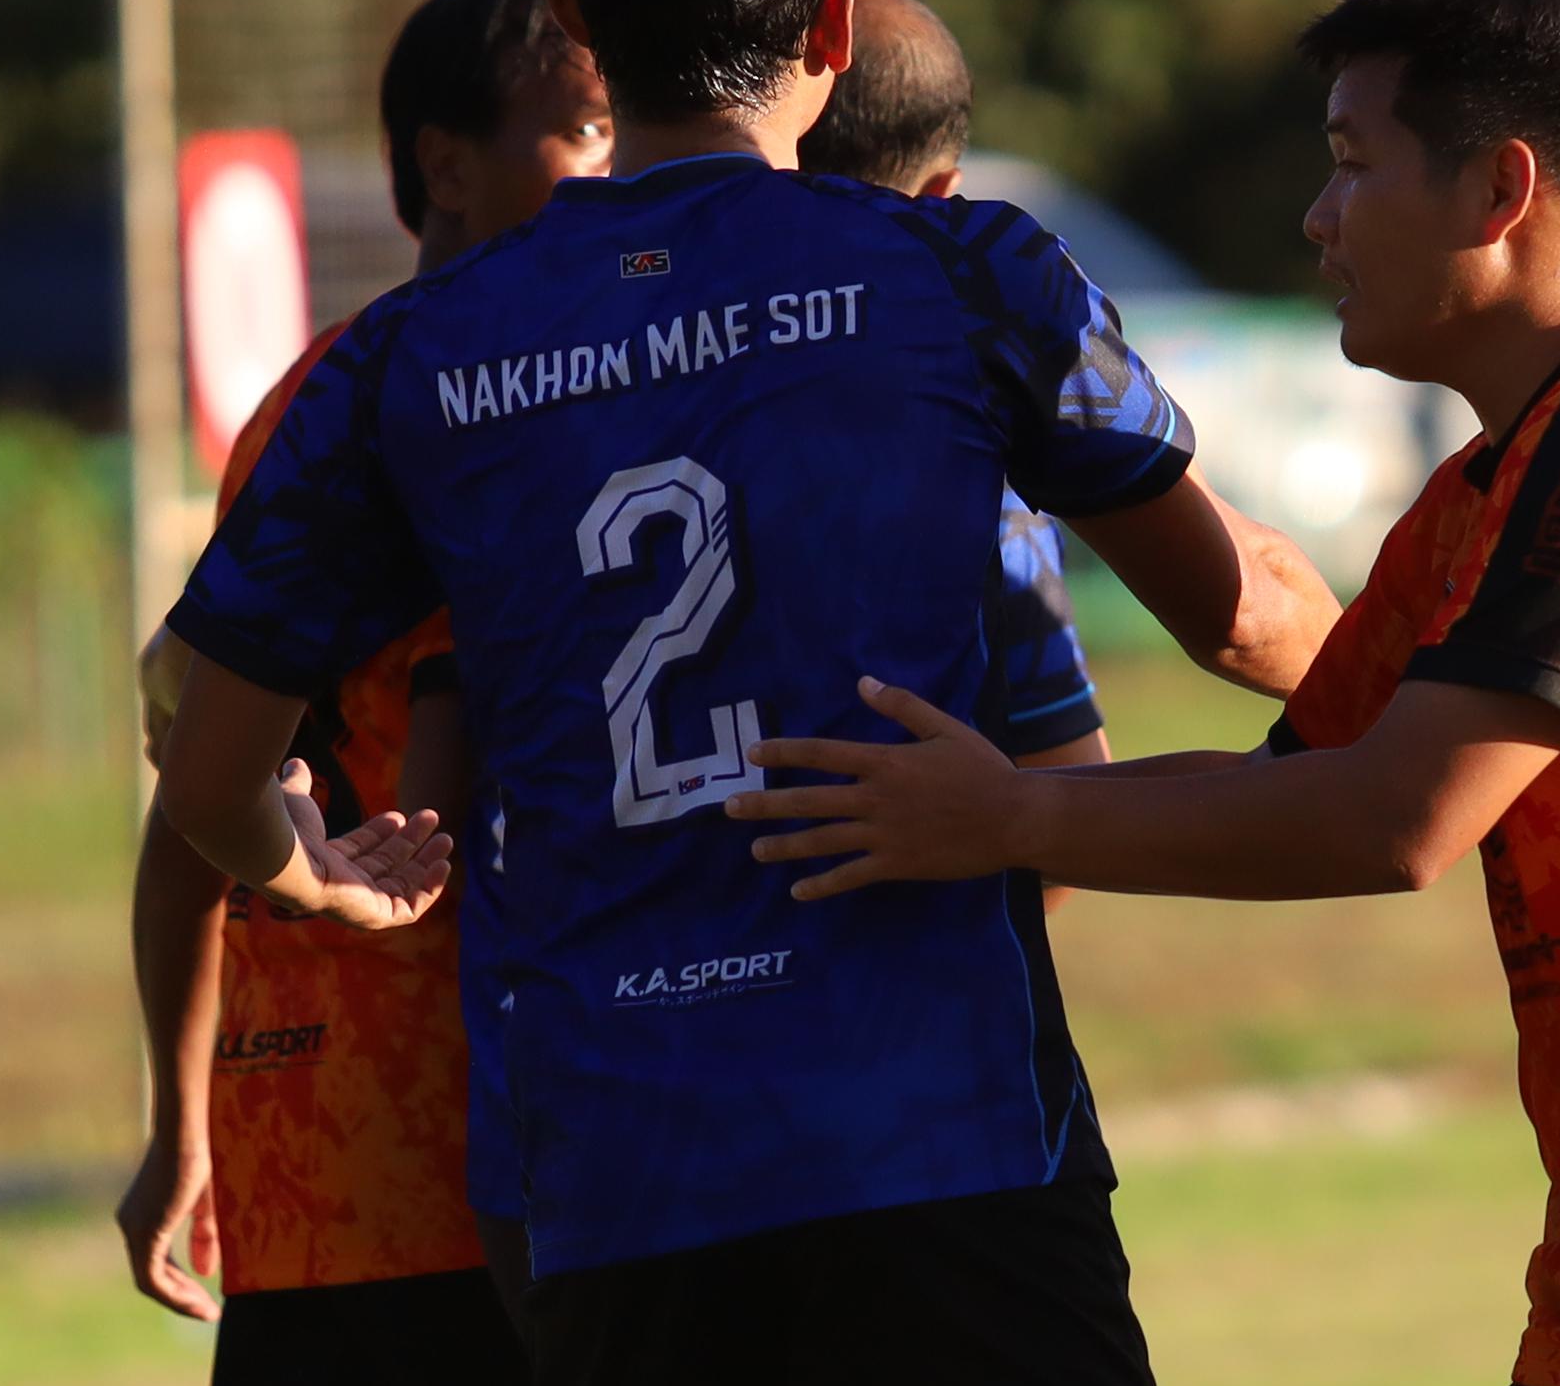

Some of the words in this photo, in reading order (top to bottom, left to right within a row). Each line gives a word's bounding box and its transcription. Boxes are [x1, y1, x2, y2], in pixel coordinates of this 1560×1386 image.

[621, 251, 670, 278] KAS
[438, 338, 631, 427] NAKHON
[647, 302, 749, 379] MAE
[769, 283, 865, 345] SOT
[575, 455, 765, 829] 2
[614, 949, 792, 998] K.A.SPORT
